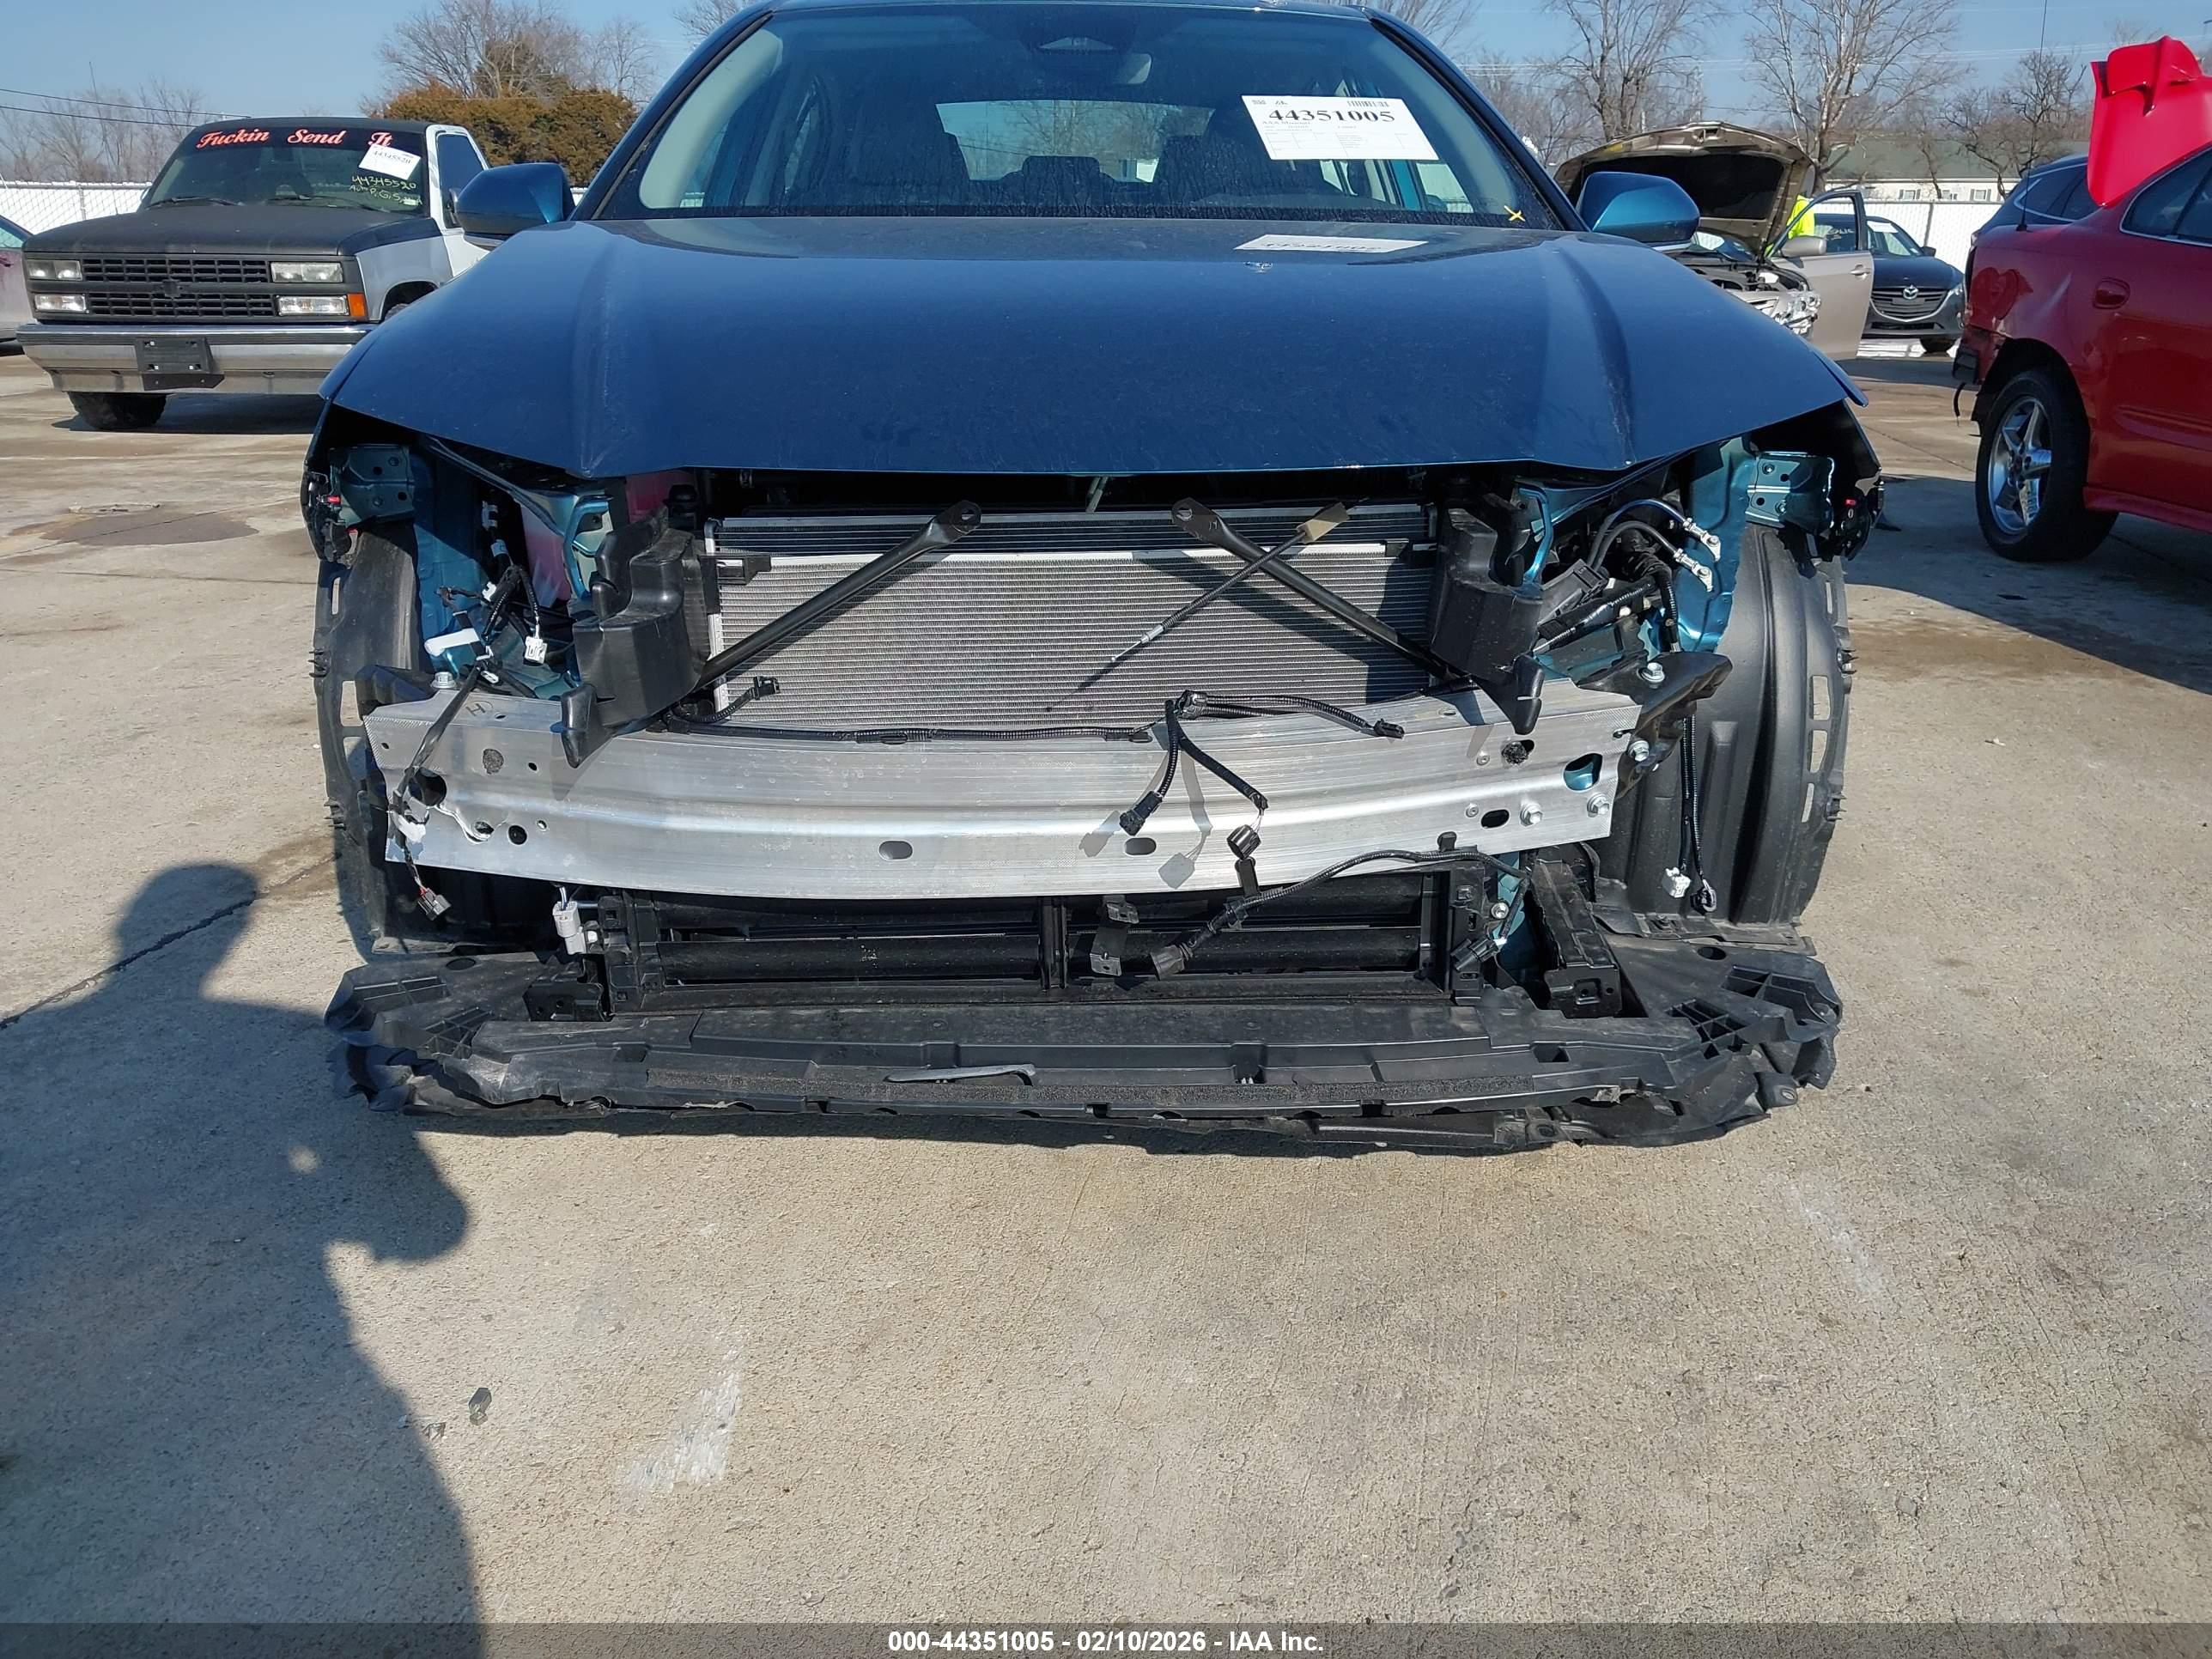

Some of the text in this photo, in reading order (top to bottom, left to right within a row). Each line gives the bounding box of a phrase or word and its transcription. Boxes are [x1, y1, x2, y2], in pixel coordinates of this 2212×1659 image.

[1268, 110, 1395, 122] 44351005
[196, 129, 392, 149] Fuckin Send It
[351, 175, 417, 191] 44345520
